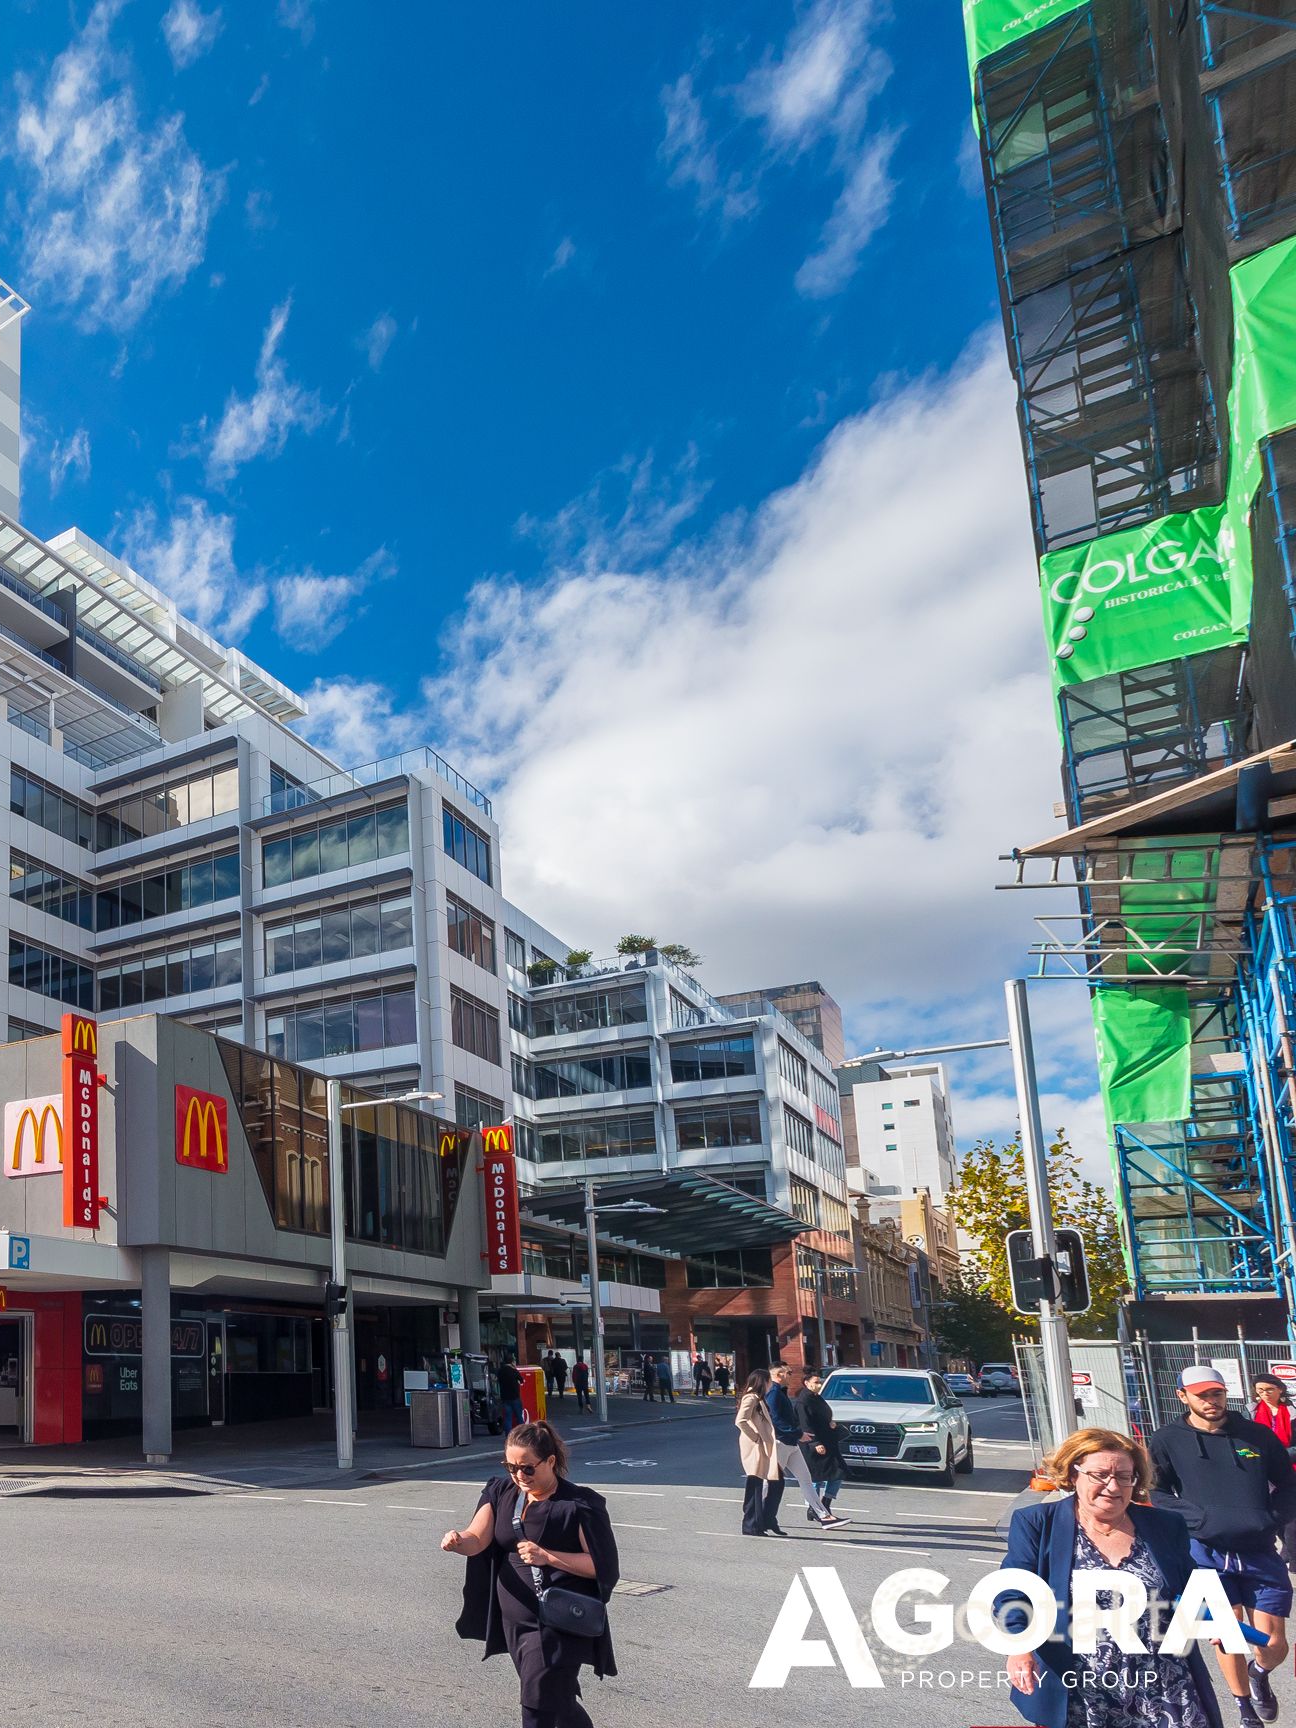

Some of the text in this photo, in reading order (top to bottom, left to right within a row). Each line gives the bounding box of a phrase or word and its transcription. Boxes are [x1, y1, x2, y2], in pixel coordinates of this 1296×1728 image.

[79, 1069, 92, 1222] McDonald's
[491, 1163, 508, 1270] McDonald's
[119, 1367, 138, 1378] Uber
[119, 1380, 138, 1391] Eats
